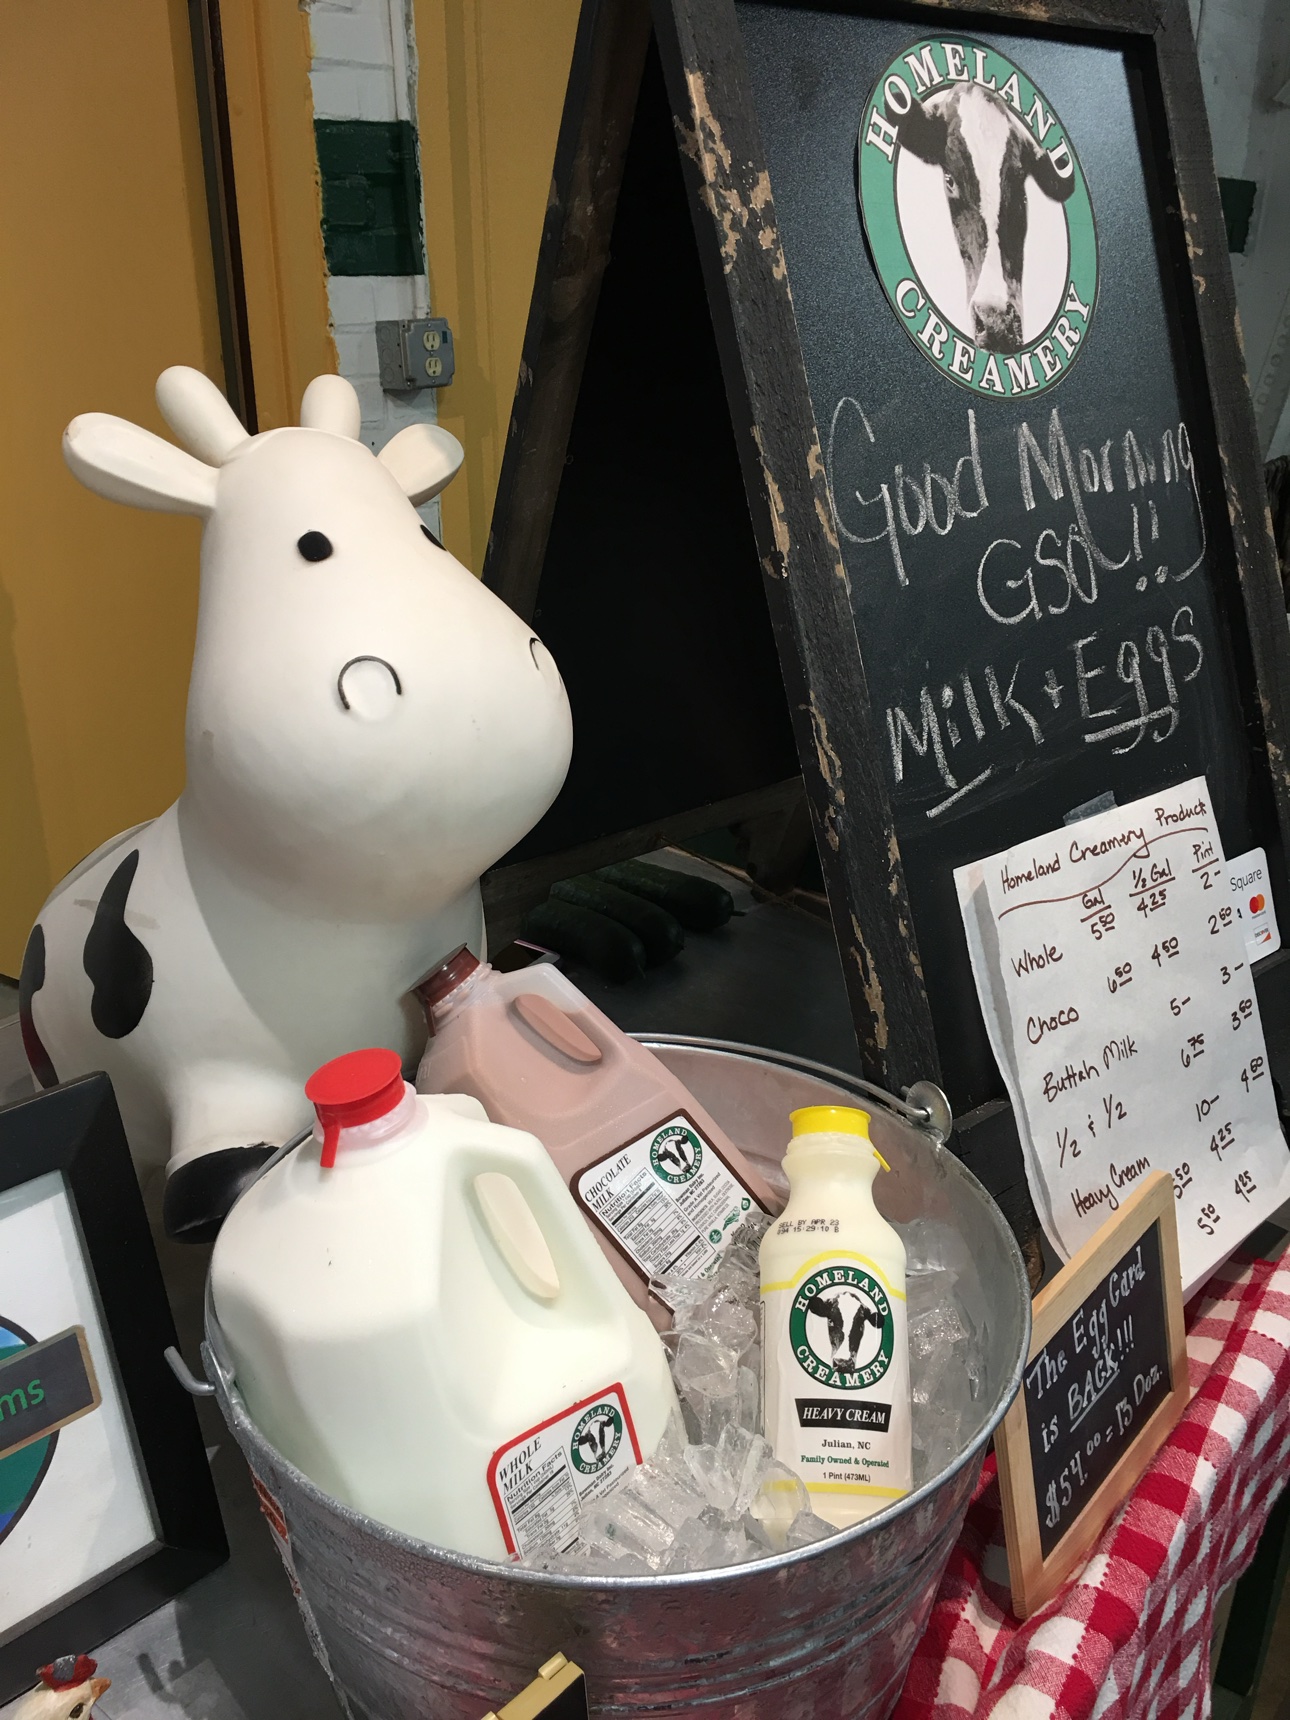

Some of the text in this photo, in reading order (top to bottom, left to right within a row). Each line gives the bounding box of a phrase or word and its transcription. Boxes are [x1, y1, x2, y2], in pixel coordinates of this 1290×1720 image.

[865, 42, 1075, 179] HOMELAND
[895, 278, 1091, 394] CREAMERY
[826, 396, 1207, 587] Good Morning
[1074, 605, 1203, 755] Eggs
[1000, 798, 1207, 894] Homeland Creamery Product
[1081, 887, 1106, 911] Gal
[1150, 859, 1173, 885] Gal
[1192, 841, 1215, 864] Pint
[1230, 869, 1262, 892] Square
[1011, 944, 1063, 978] Whole
[1027, 1007, 1080, 1044] Choco
[1103, 1035, 1138, 1070] Milk
[652, 1127, 688, 1166] HOMELAND
[667, 1147, 702, 1183] CREAMERY
[584, 1153, 632, 1203] CHOCOLATE
[1070, 1182, 1120, 1218] Heavy
[1109, 1157, 1151, 1189] Cream
[591, 1186, 615, 1212] MILK
[601, 1187, 629, 1216] Nutrition
[778, 1221, 793, 1229] SELL
[810, 1218, 826, 1226] APR
[795, 1268, 889, 1318] HOMELAND
[1026, 1245, 1146, 1399] The Egg Card
[797, 1345, 889, 1387] CREAMERY
[572, 1406, 616, 1450] HOMELAND
[802, 1407, 887, 1424] HEAVY CREAM
[1041, 1414, 1059, 1453] is
[499, 1437, 542, 1482] WHOLE
[579, 1432, 621, 1473] CREAMERY
[800, 1455, 890, 1469] Family Owned & Operated
[821, 1439, 871, 1450] Julian, NC
[503, 1461, 534, 1496] MILK
[506, 1469, 540, 1503] Nutrition
[541, 1449, 562, 1471] Facts
[828, 1472, 843, 1480] Pint
[844, 1472, 871, 1483] (473ML)
